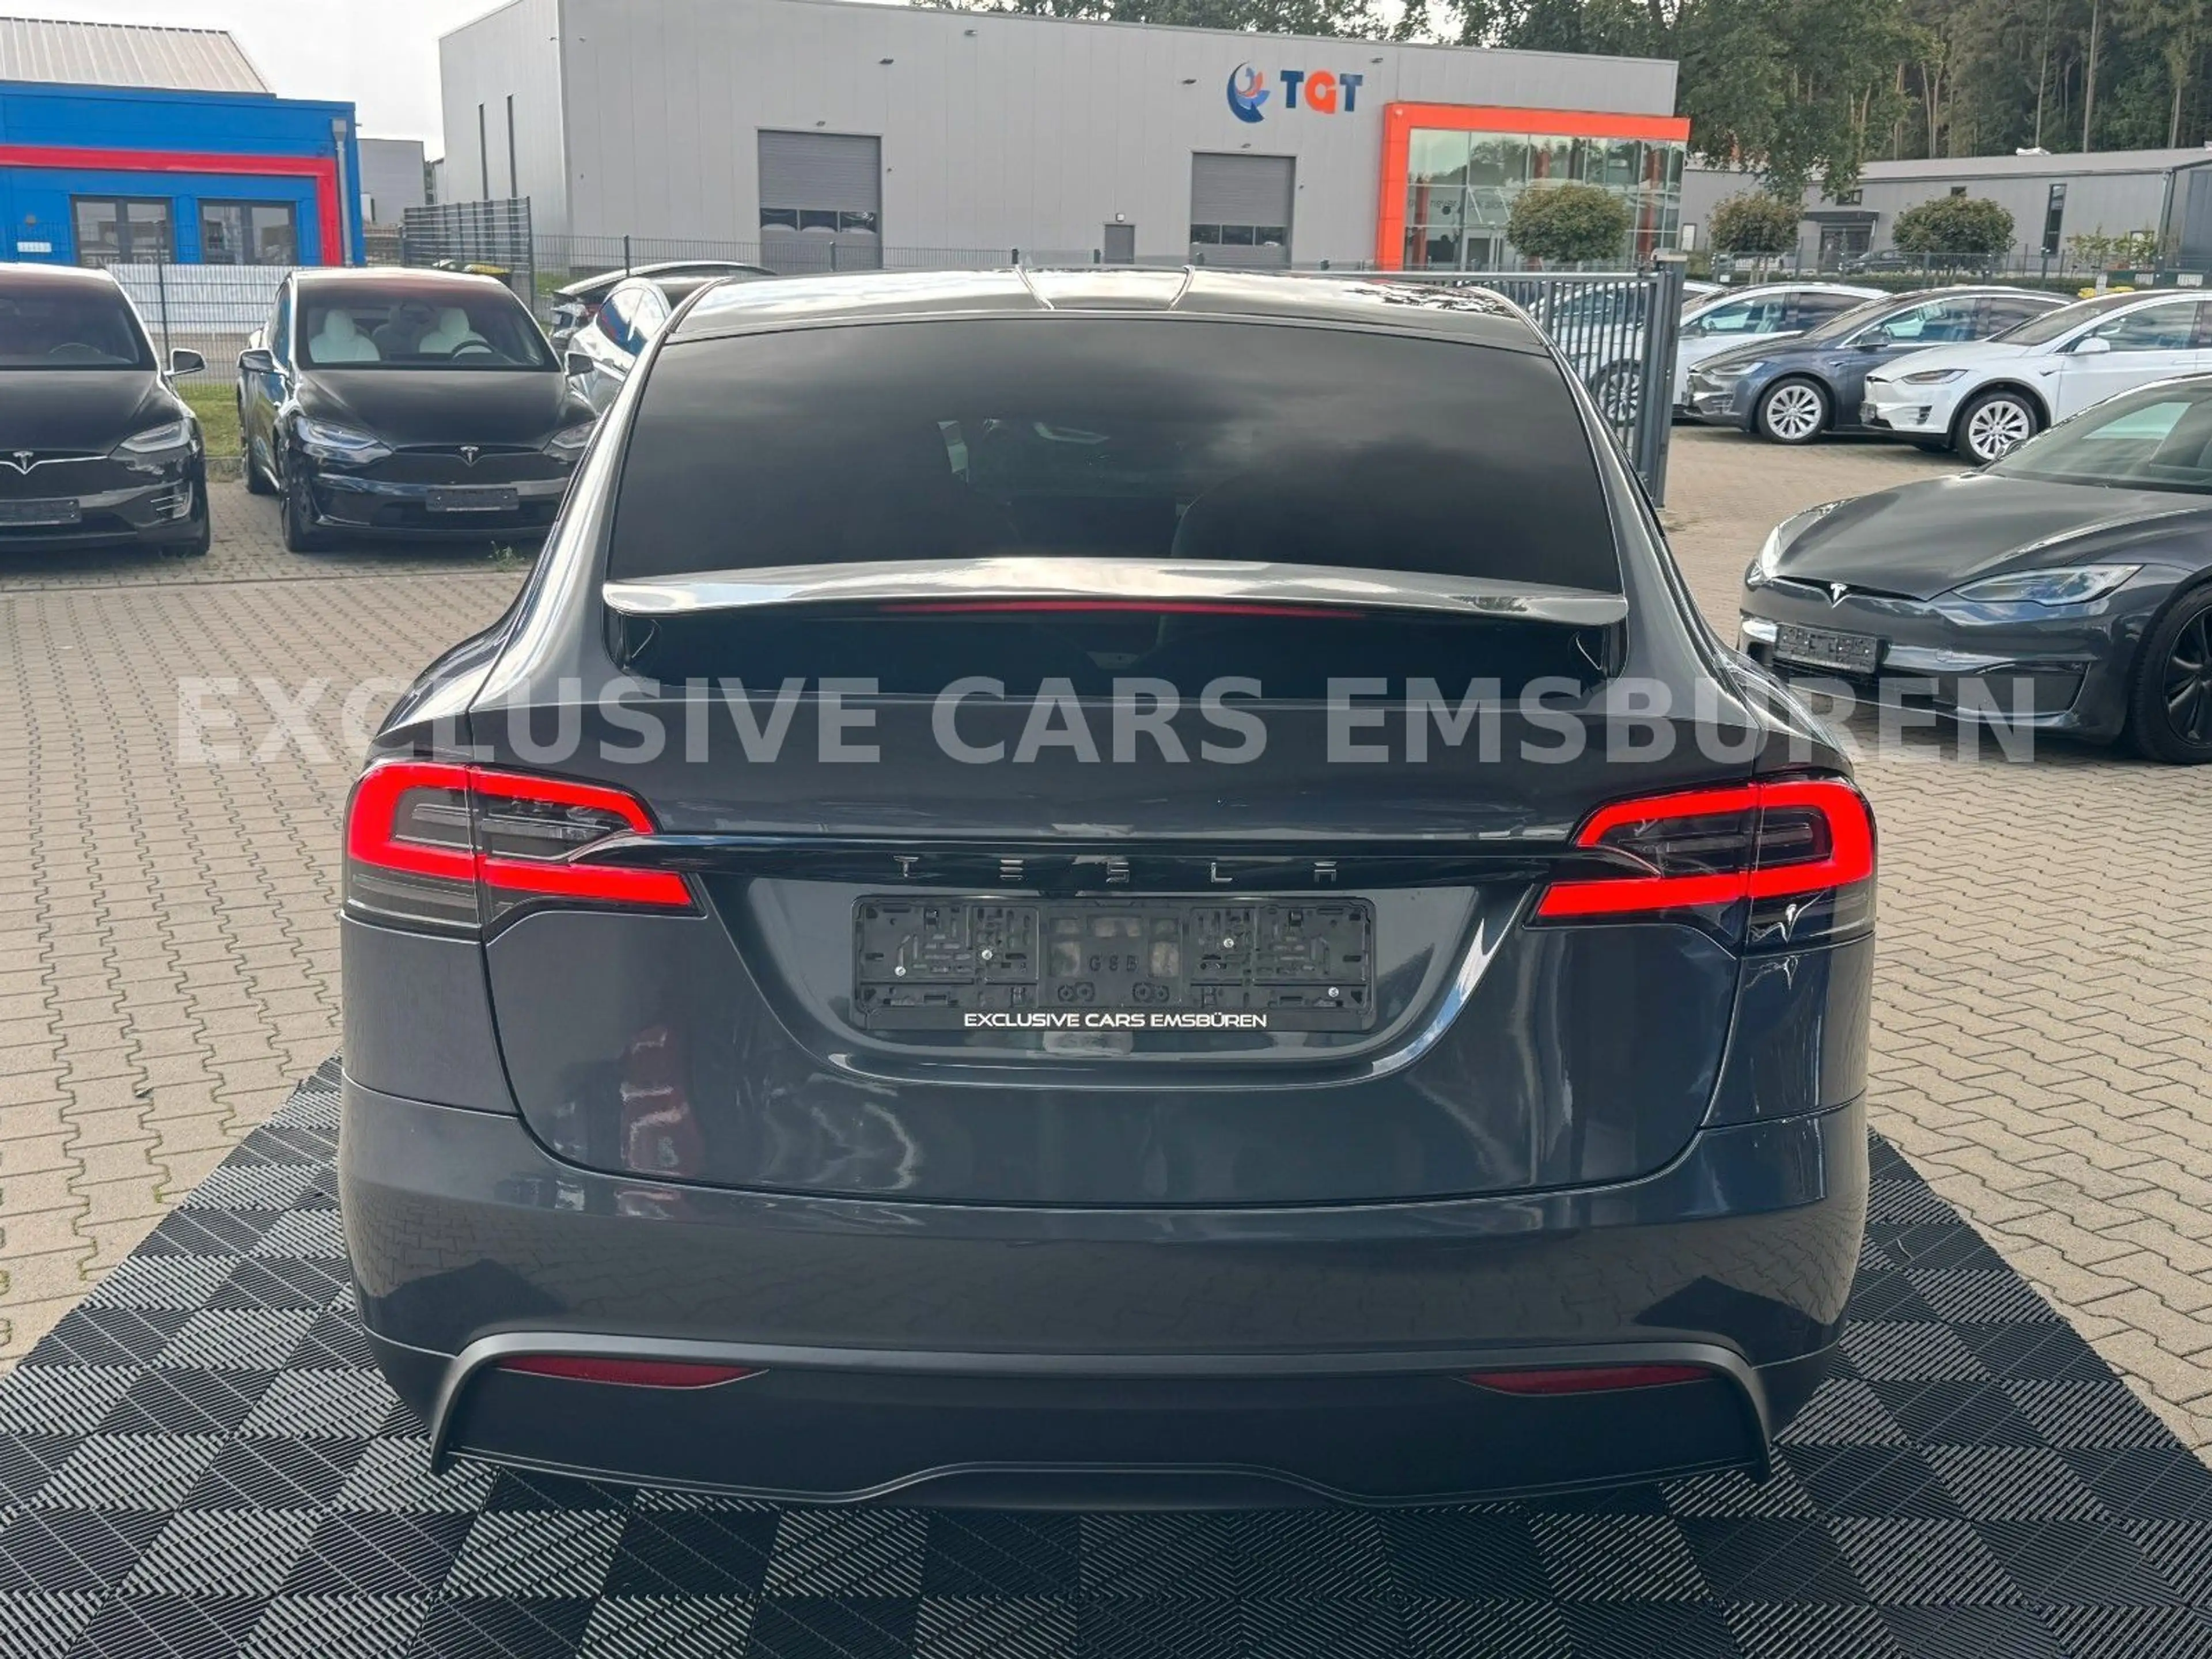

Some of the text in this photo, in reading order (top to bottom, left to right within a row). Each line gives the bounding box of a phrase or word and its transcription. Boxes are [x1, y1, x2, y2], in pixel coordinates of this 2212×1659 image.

[1280, 70, 1363, 114] TGT
[894, 856, 1338, 882] TESLA
[964, 1011, 1268, 1027] EXCLUSIVE CARS EMSBÜREN
